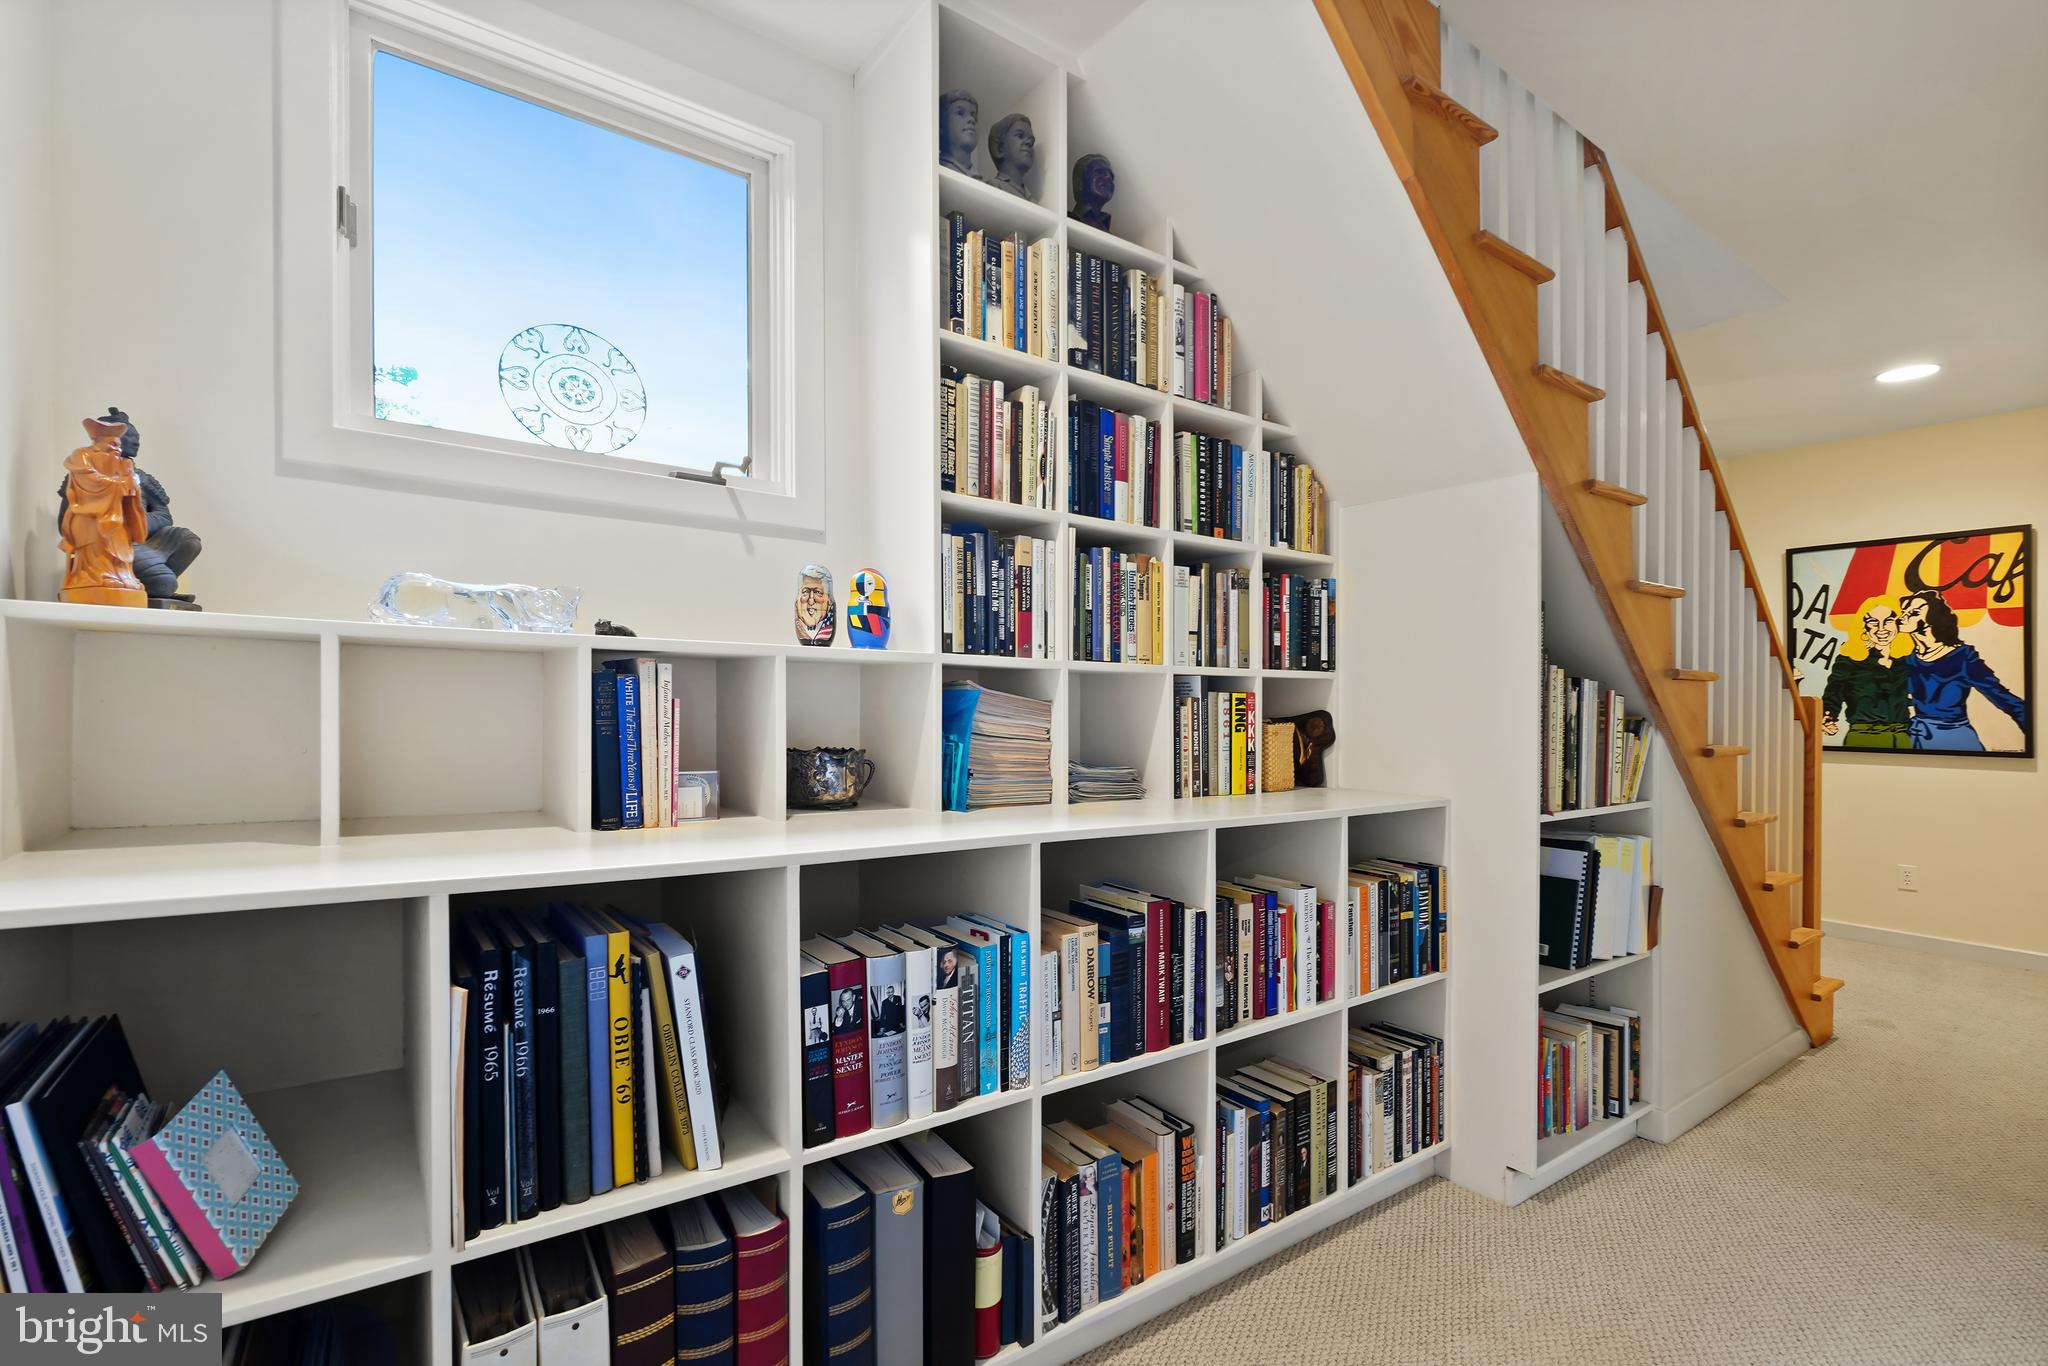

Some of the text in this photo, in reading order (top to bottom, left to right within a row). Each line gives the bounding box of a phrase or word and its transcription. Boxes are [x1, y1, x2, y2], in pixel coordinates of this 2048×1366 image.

[955, 276, 964, 291] Jim
[947, 388, 956, 475] The Making of Black
[1102, 434, 1114, 492] Simple Justice
[991, 560, 999, 612] Walk with Me
[1128, 570, 1136, 633] Unlikely Heroes
[660, 679, 671, 748] Infants and Mothers
[1223, 696, 1231, 740] 1861
[1234, 697, 1247, 733] KING
[625, 676, 638, 818] WHITE The First Three Years of LIFE
[1614, 717, 1623, 775] KILIMS
[1418, 889, 1430, 930] LINCOLN
[1087, 947, 1096, 1000] DARROW
[1158, 976, 1166, 1004] TWAIN
[1306, 946, 1314, 994] The Children
[537, 1006, 555, 1015] 1966
[684, 998, 695, 1036] STANFORD
[949, 993, 958, 1058] John Adams
[962, 984, 975, 1044] TITAN
[1019, 980, 1027, 1021] TRAFFIC
[484, 1045, 499, 1082] 1965
[515, 1041, 529, 1078] 1966
[613, 1016, 632, 1105] OBIE '69
[688, 1036, 698, 1059] CLASS
[692, 1058, 701, 1079] BOOK
[834, 1052, 864, 1066] MASTER
[835, 1062, 863, 1075] SENATE
[662, 1023, 690, 1137] OBERLIN COLLEGE 1973
[1327, 1110, 1337, 1178] NO ORDINARY TIME
[1071, 1215, 1078, 1225] K.
[1087, 1198, 1098, 1292] Benjamin Franklin
[1106, 1204, 1114, 1269] BULLY PULPIT
[1186, 1219, 1193, 1231] OF
[1071, 1227, 1081, 1311] PETER THE GREAT
[1082, 1199, 1090, 1296] WALTER ISAACSON
